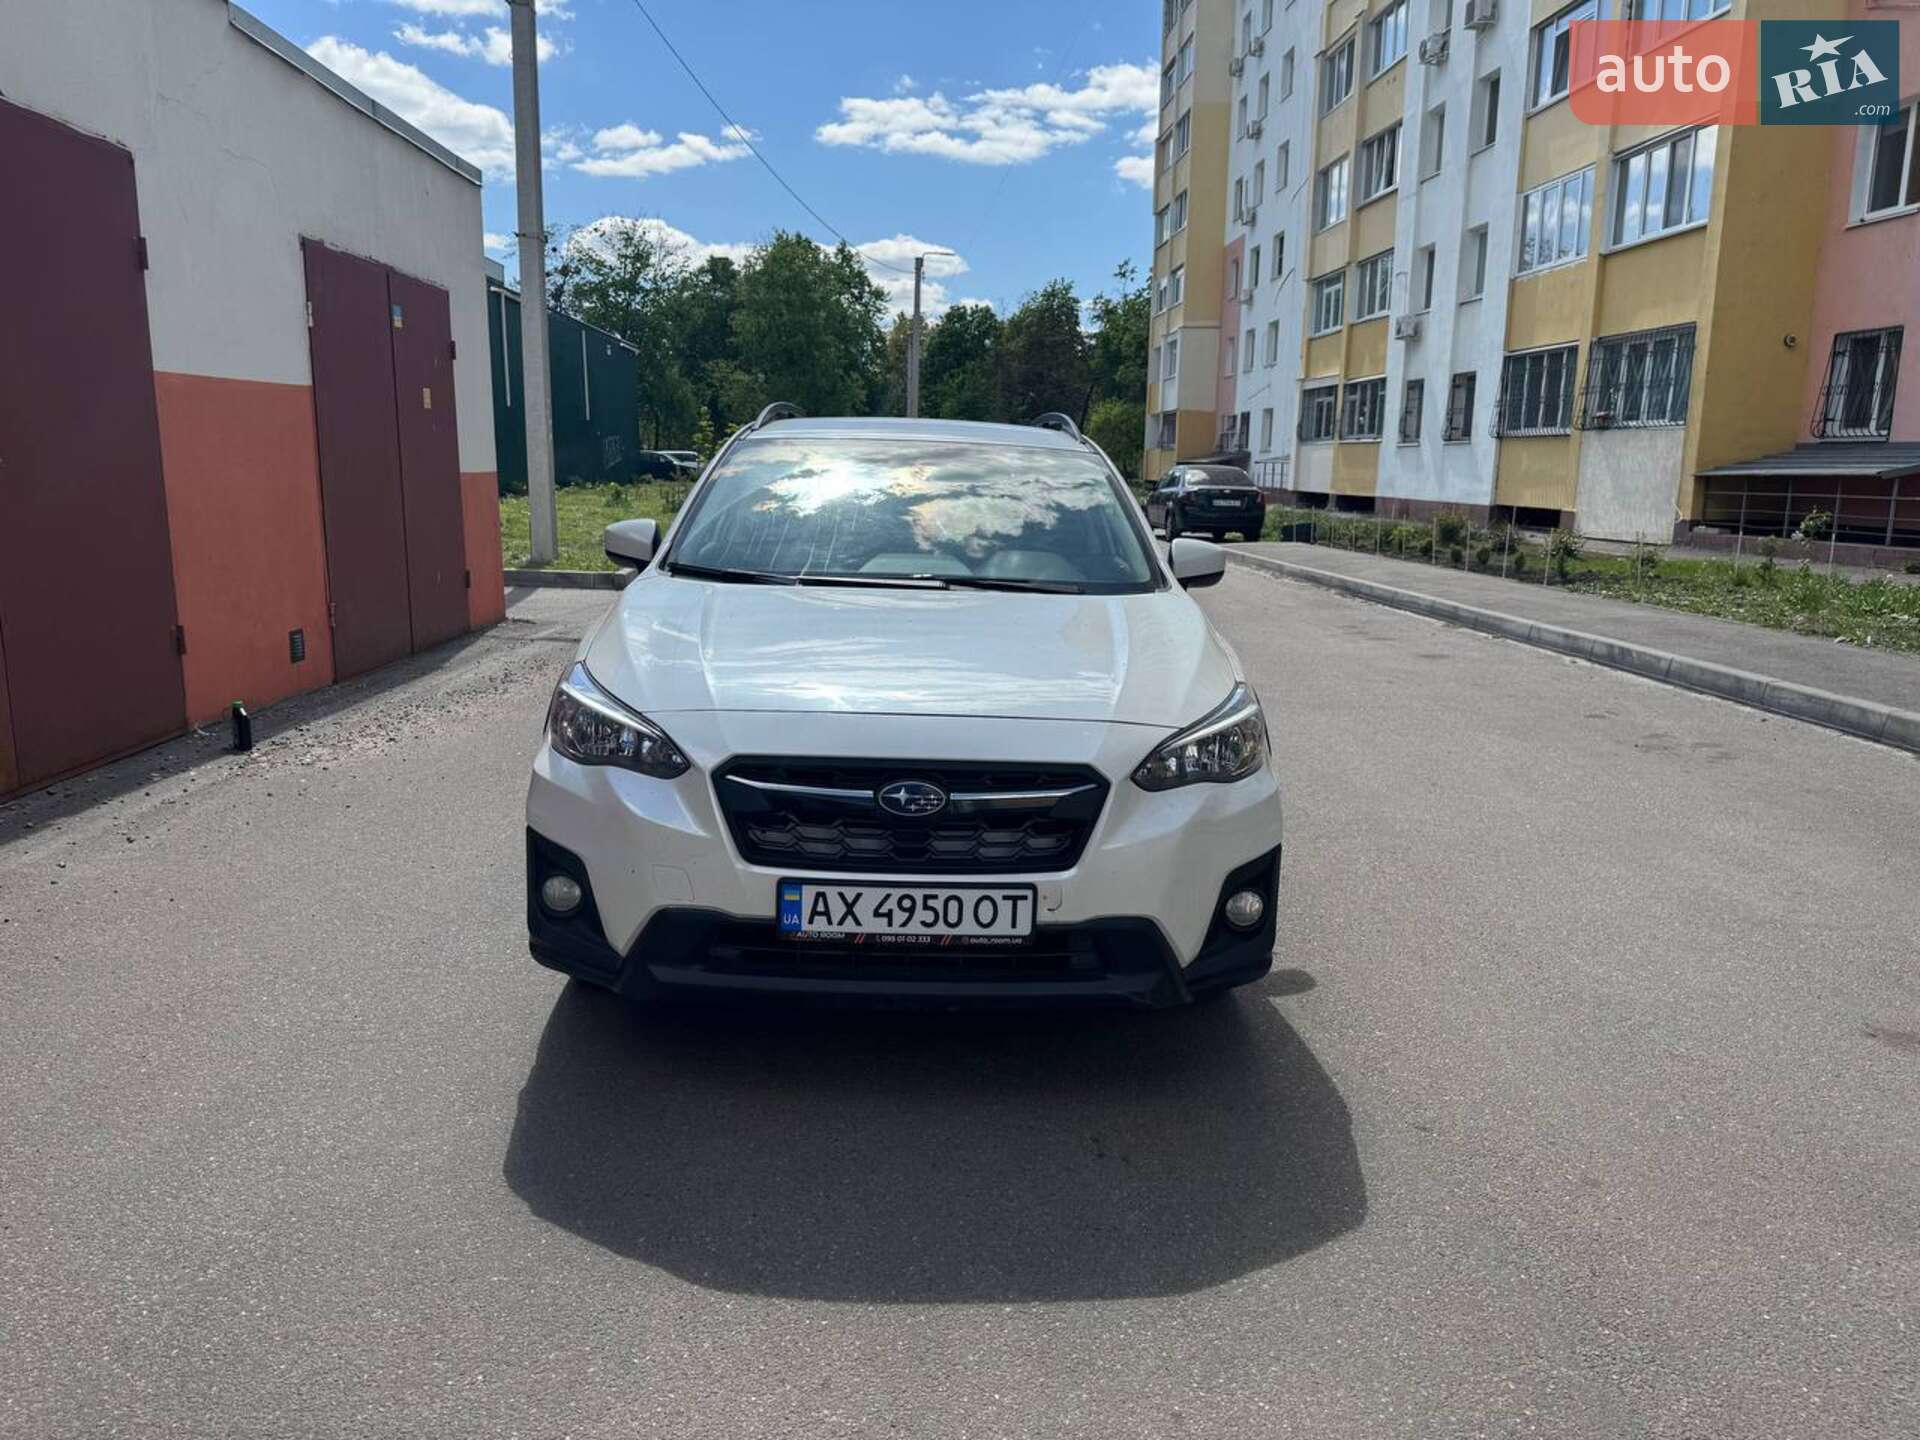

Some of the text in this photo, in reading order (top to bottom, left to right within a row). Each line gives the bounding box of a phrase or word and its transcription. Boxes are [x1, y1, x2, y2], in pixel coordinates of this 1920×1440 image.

[784, 913, 799, 925] UA
[807, 891, 1028, 929] AX 4950 OT
